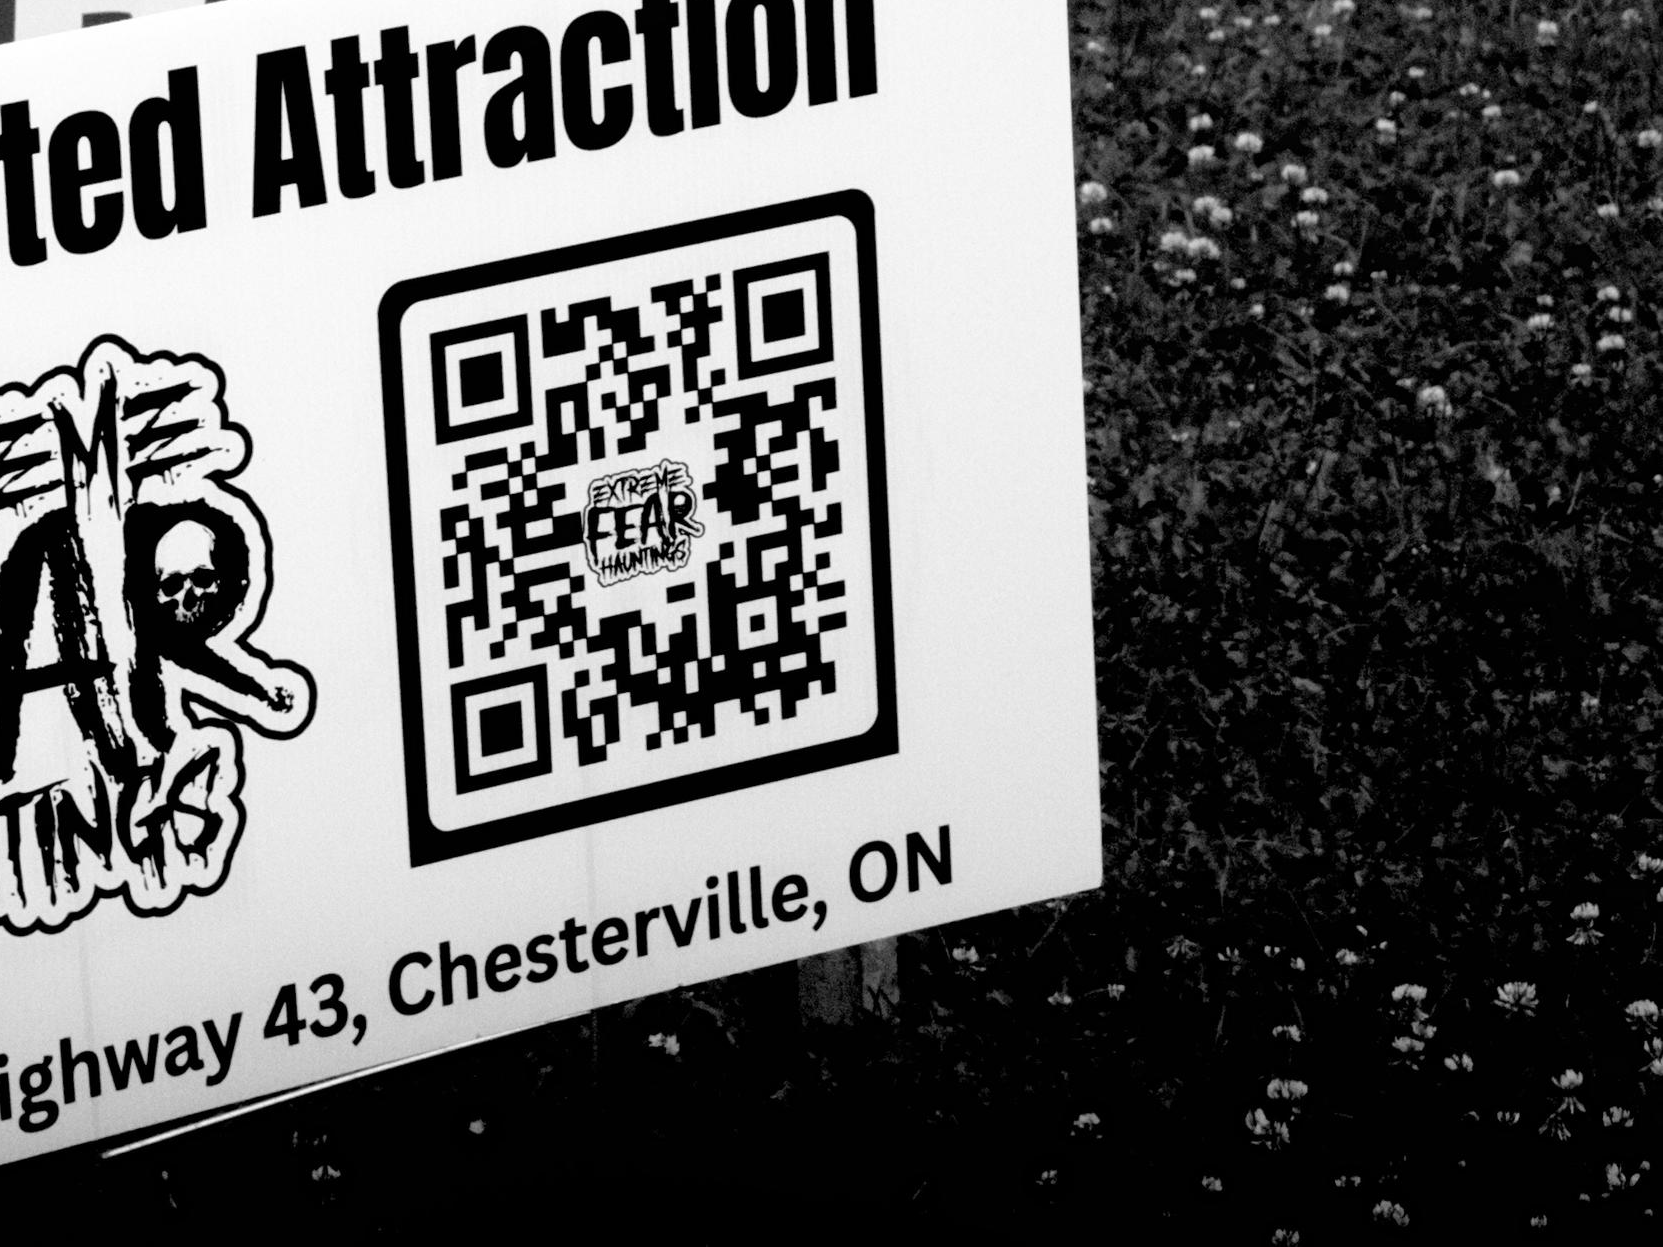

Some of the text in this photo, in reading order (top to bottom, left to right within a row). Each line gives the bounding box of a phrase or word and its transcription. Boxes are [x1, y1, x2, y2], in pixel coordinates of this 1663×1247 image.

[592, 466, 686, 506] EXTREME
[586, 491, 700, 566] FEAR
[600, 539, 687, 580] HAUNTINGS
[263, 973, 367, 1047] 43,
[388, 866, 828, 1016] Chesterville,
[849, 824, 953, 903] ON
